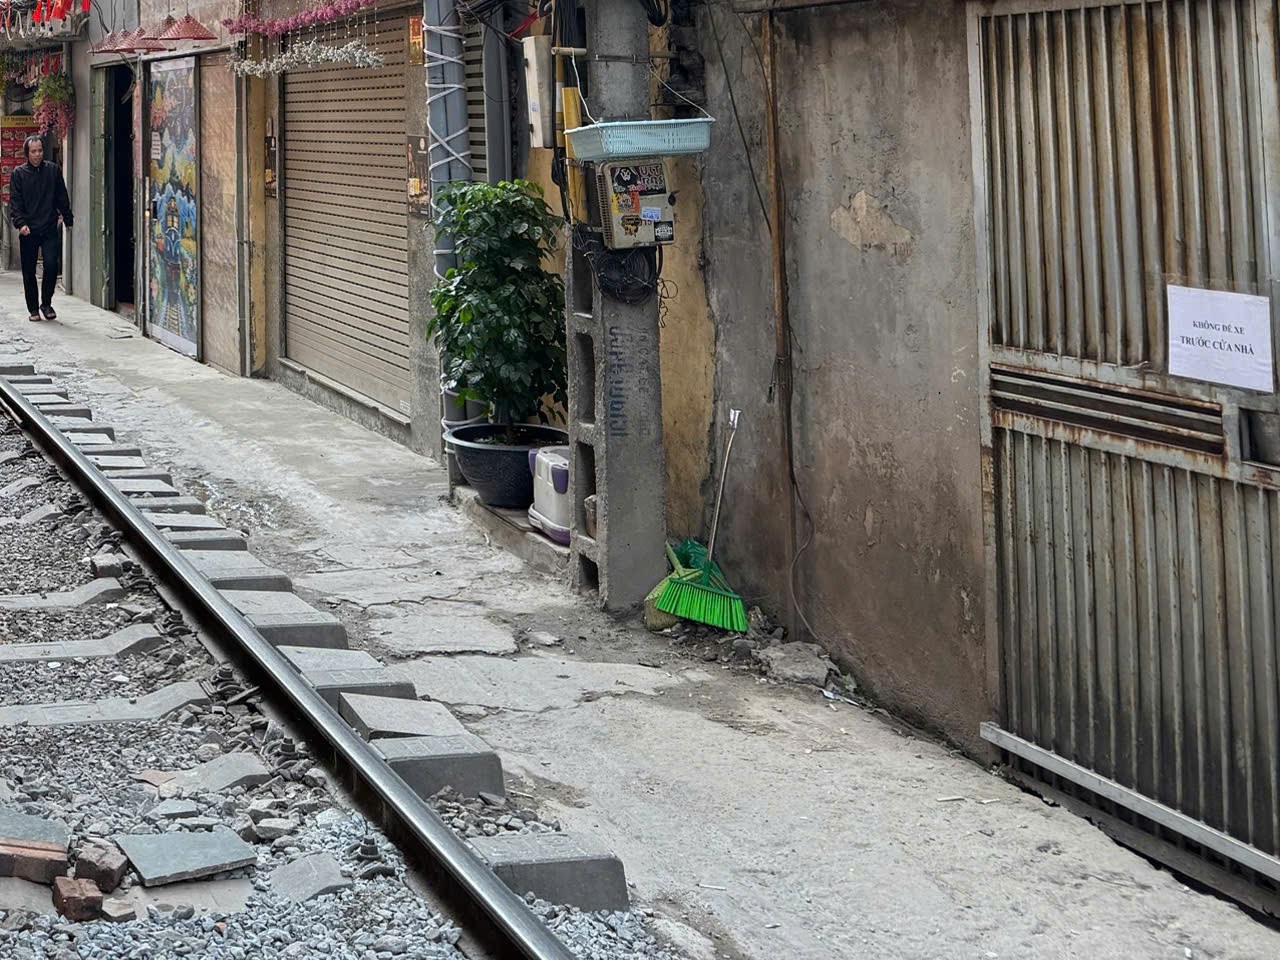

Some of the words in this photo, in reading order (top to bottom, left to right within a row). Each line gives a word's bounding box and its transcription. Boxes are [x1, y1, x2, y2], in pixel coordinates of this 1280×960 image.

[1193, 320, 1220, 332] KHÔNG
[1234, 326, 1246, 335] XE
[1180, 335, 1211, 349] TRƯỚC
[1234, 344, 1255, 355] NHÀ
